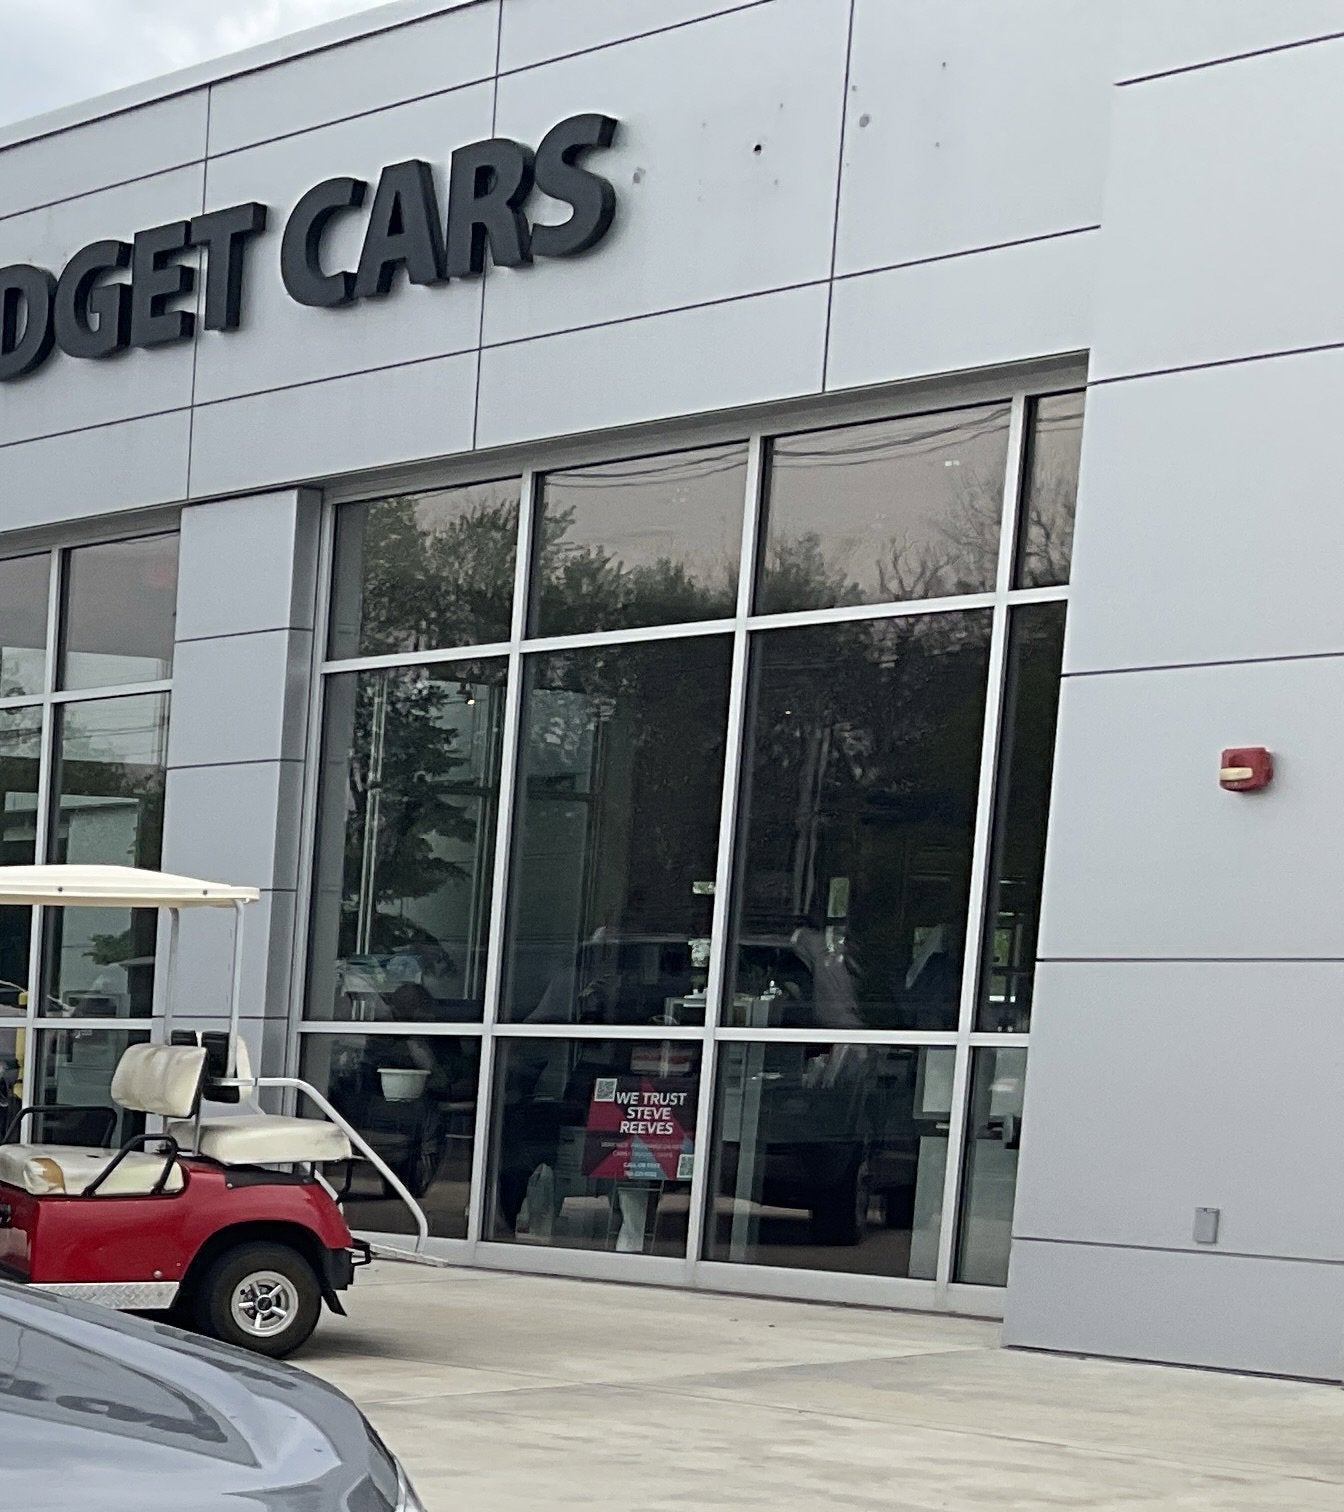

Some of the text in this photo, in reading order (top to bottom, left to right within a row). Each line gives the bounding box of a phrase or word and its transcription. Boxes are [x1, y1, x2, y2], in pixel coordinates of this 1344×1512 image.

[280, 112, 619, 308] CARS
[617, 1092, 687, 1105] WE TRUST
[626, 1107, 671, 1119] STEVE
[619, 1121, 673, 1134] REEVES
